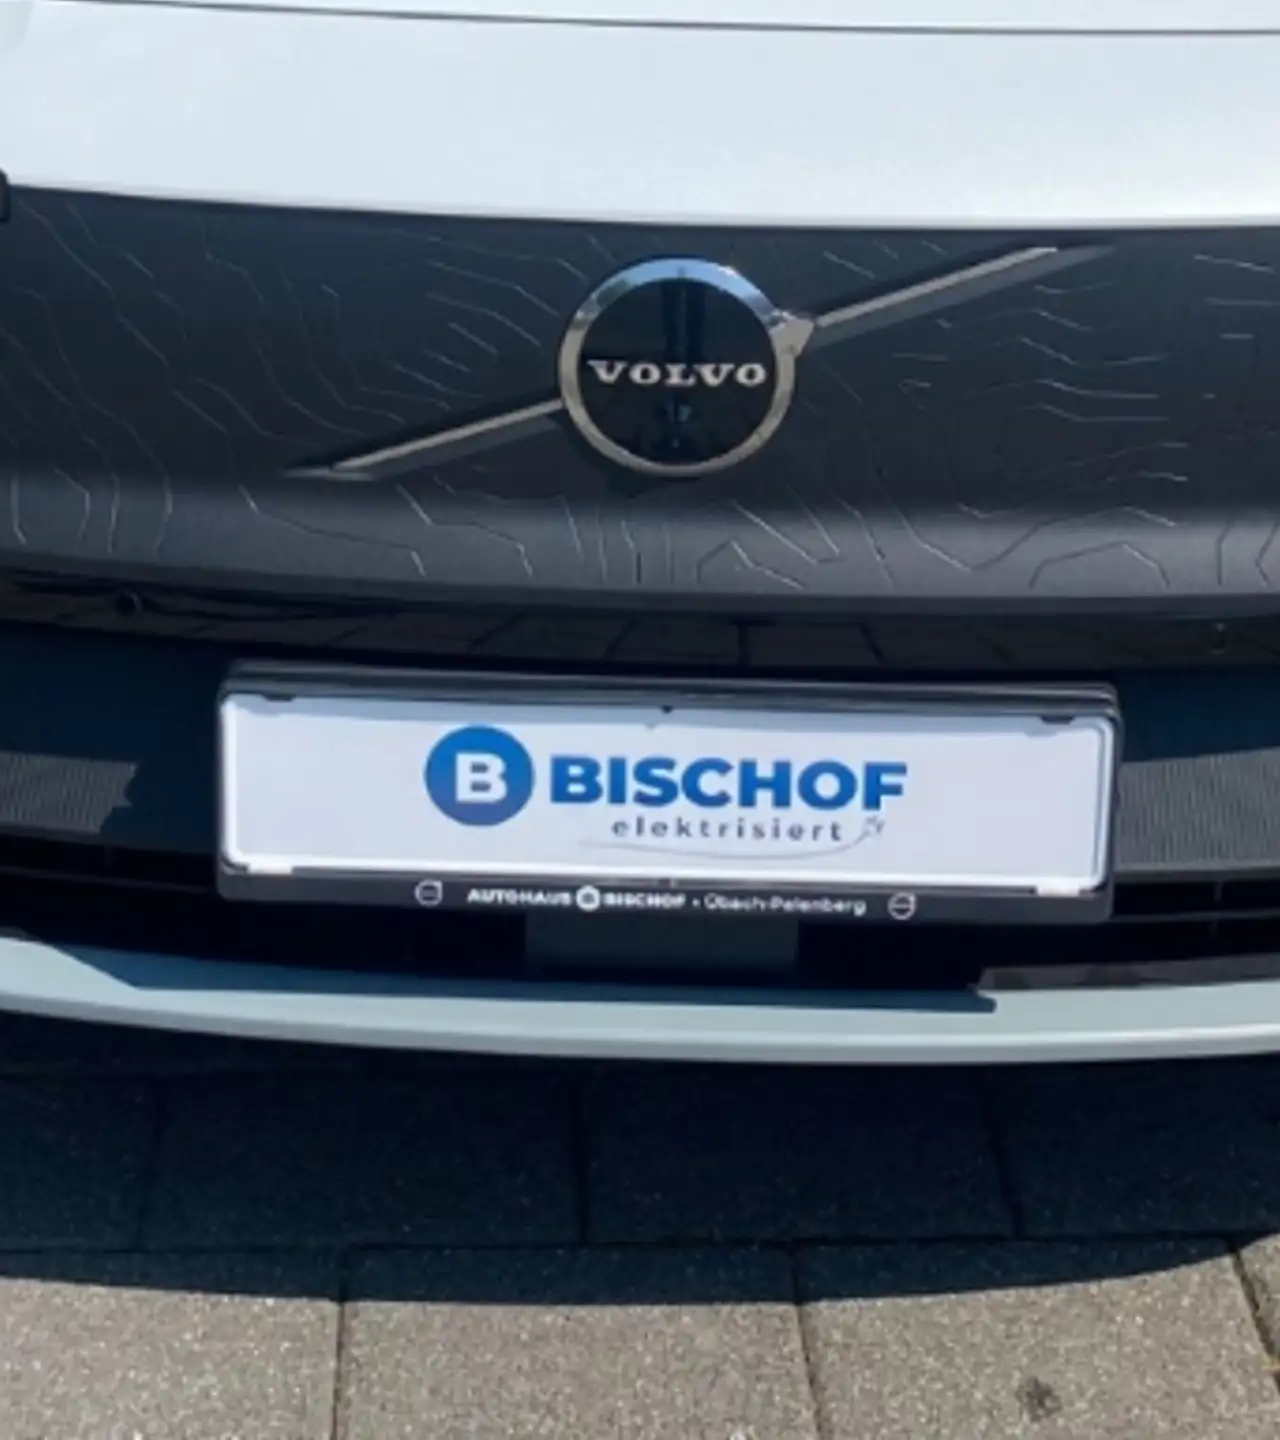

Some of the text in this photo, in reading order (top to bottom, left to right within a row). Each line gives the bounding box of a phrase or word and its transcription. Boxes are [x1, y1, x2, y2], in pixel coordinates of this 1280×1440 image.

[587, 359, 767, 387] VOLVO
[454, 751, 908, 811] B BISCHOF
[611, 816, 843, 842] elektrisiert
[468, 888, 571, 906] AUTOHAUS
[603, 891, 686, 909] BISCHOF
